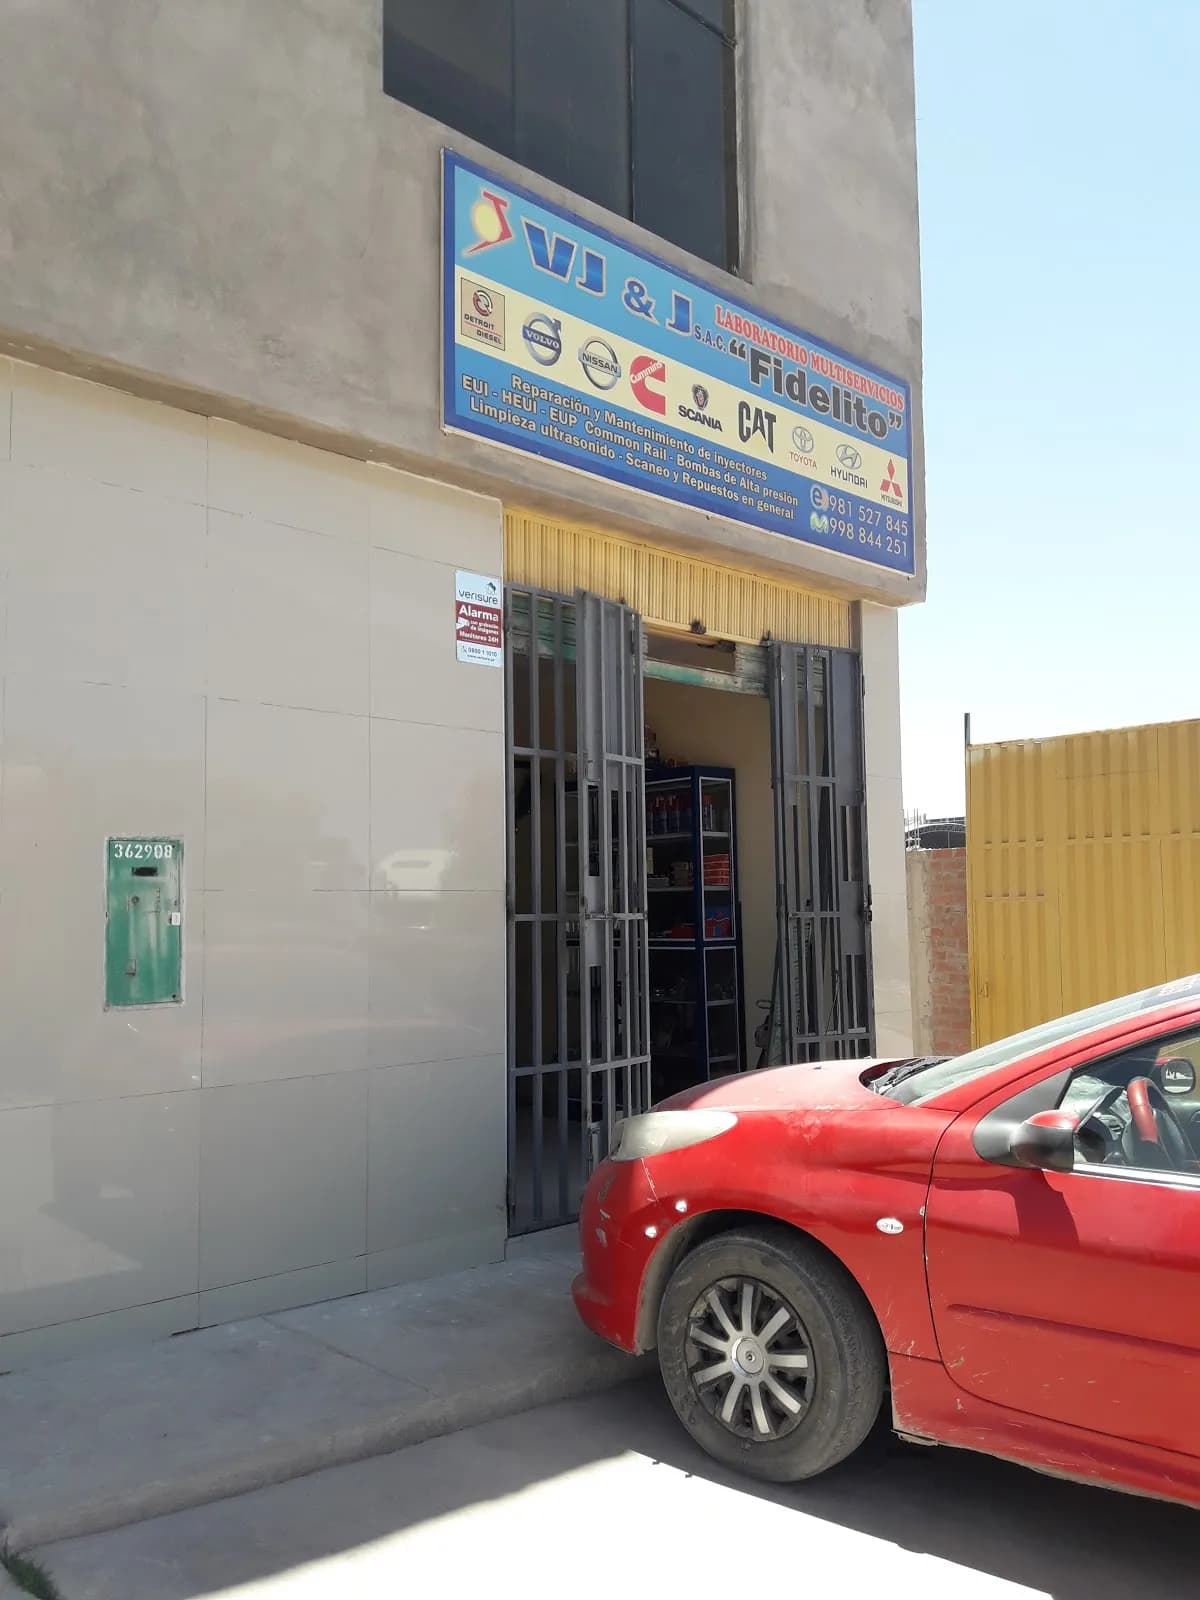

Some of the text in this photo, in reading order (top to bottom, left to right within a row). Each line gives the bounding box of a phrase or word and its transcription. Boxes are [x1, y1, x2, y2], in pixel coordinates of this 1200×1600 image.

[464, 314, 494, 331] DETROIT
[621, 276, 661, 327] &
[665, 290, 692, 336] J
[694, 325, 727, 352] S.A.C.
[476, 329, 502, 345] DIESEL
[525, 329, 560, 349] VOLVO
[582, 352, 618, 374] NISSAN
[714, 305, 905, 411] LABORATORIO MULTISERVICIOS
[630, 360, 664, 385] Cummins
[511, 374, 768, 481] Reparación y Mantenimiento de inyectores
[678, 405, 723, 432] SCANIA
[738, 400, 777, 454] CAT
[462, 374, 489, 397] EUI
[502, 389, 537, 415] HEUI
[549, 406, 578, 427] EUP
[584, 419, 640, 451] Common
[643, 441, 667, 461] Rail
[676, 453, 721, 480] Bombas
[723, 471, 737, 485] de
[739, 478, 760, 494] Alta
[763, 486, 799, 507] presión
[470, 397, 537, 432] Limpieza
[540, 422, 616, 460] ultrasonido
[625, 452, 670, 478] Scaneo
[672, 471, 679, 483] y
[682, 471, 739, 502] Repuestos
[741, 493, 754, 507] en
[757, 499, 794, 521] general
[789, 452, 818, 470] TOYOTA
[830, 466, 868, 489] HYUNDAI
[829, 495, 908, 537] 981 527 845
[830, 517, 907, 557] 998 844 251
[459, 589, 499, 605] verisure
[459, 604, 499, 622] Alarma
[114, 843, 173, 859] 362908
